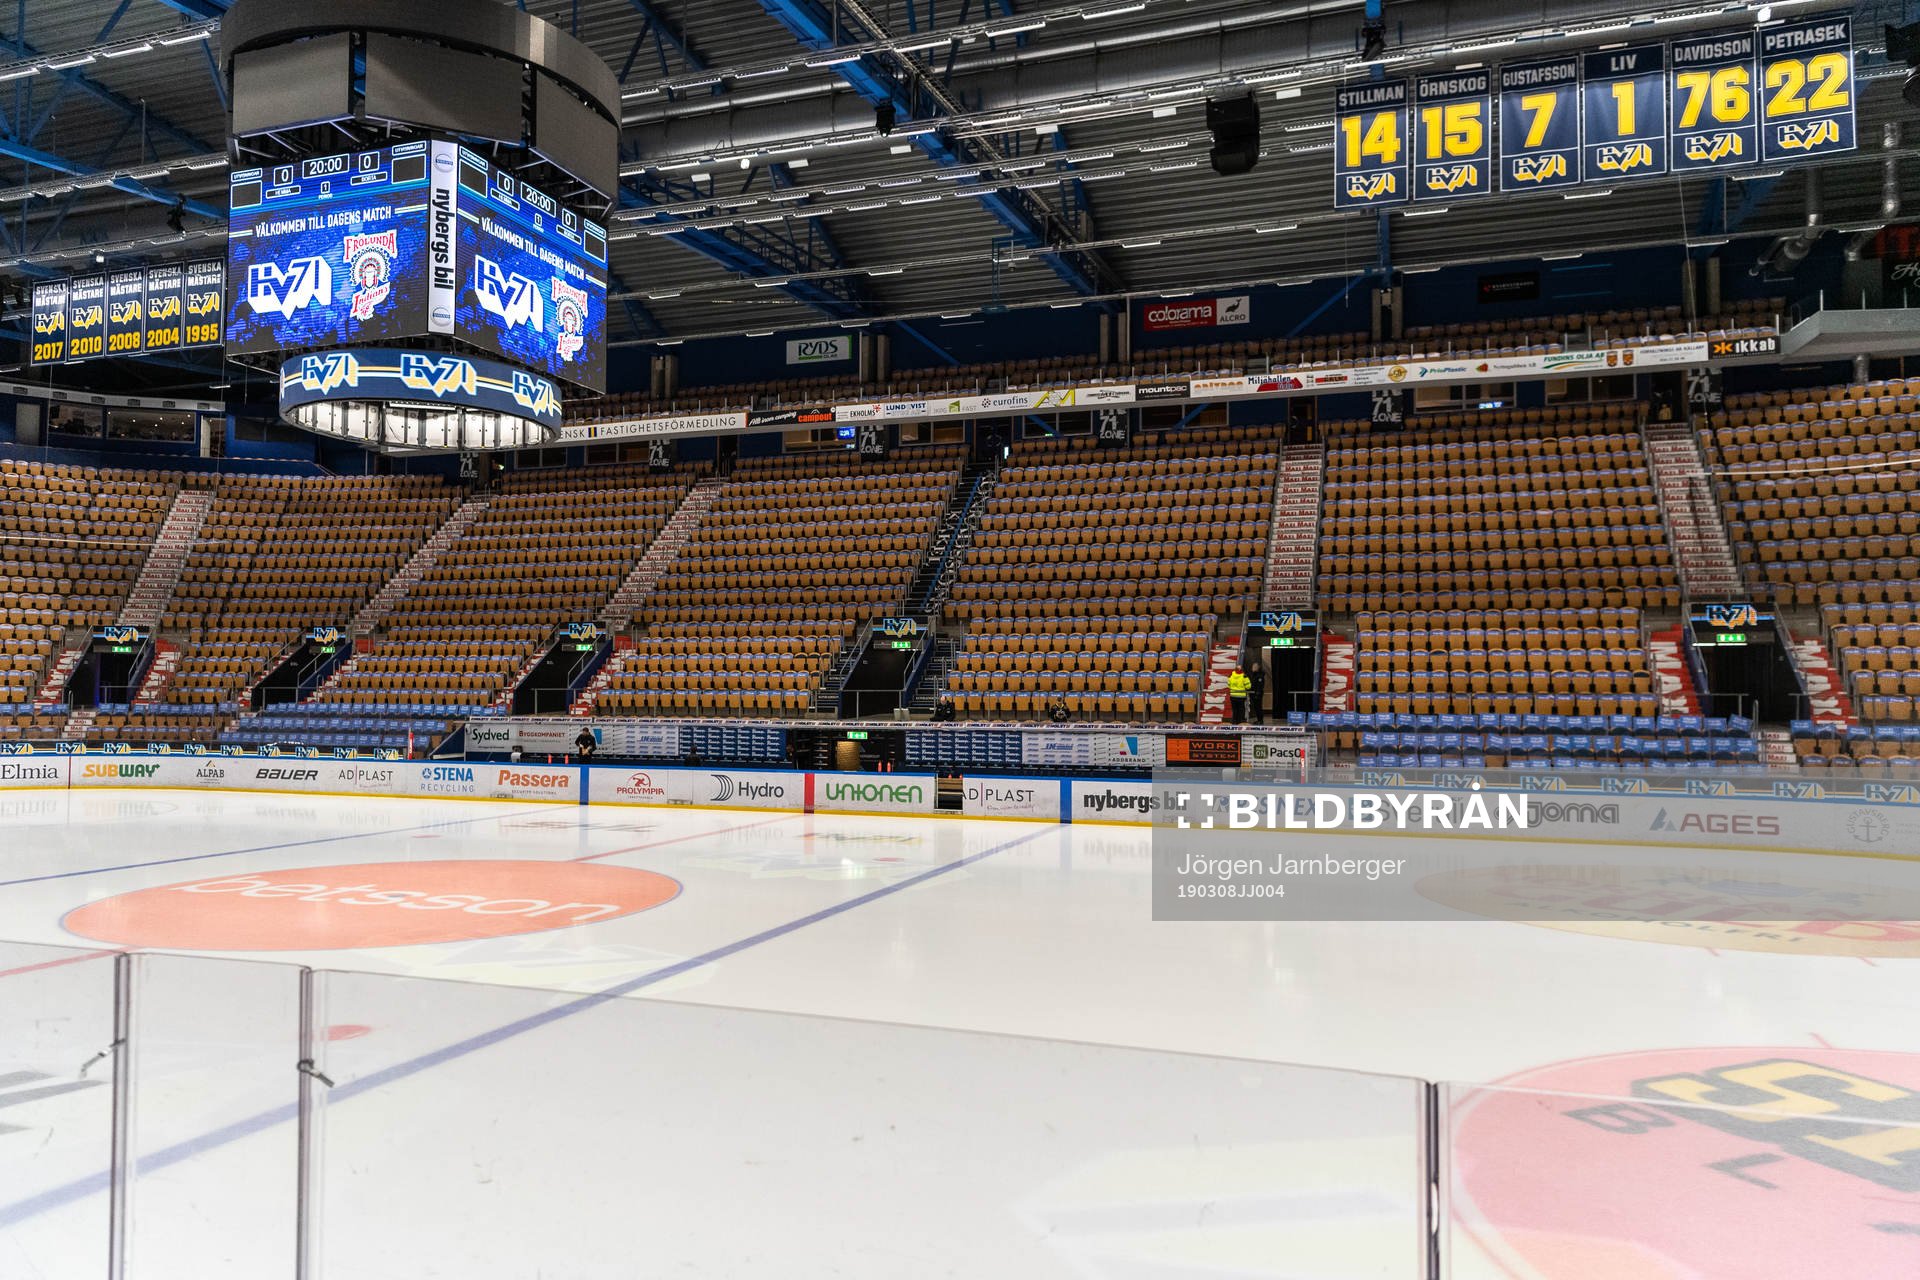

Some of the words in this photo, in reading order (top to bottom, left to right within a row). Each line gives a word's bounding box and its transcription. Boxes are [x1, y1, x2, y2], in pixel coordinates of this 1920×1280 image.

[1766, 24, 1847, 51] PETRASEK
[1675, 38, 1752, 63] DAVIDSSON
[1610, 54, 1637, 71] LIV
[1503, 62, 1575, 87] GUSTAFSSON
[1419, 76, 1487, 97] ÖRNSKOG
[1765, 52, 1850, 119] 22
[1339, 84, 1404, 106] STILLMAN
[1677, 65, 1749, 129] 76
[1612, 81, 1635, 137] 1
[1521, 92, 1558, 149] 7
[1342, 111, 1401, 168] 14
[1422, 102, 1483, 160] 15
[1777, 119, 1840, 153] HV71
[1686, 133, 1743, 163] HV71
[310, 158, 342, 175] 20:00
[364, 156, 371, 168] 0
[1597, 143, 1652, 173] HV71
[282, 169, 288, 181] 0
[1514, 153, 1567, 183] HV71
[504, 178, 510, 190] 0
[1347, 171, 1396, 200] HV71
[1427, 163, 1478, 192] HV71
[527, 188, 550, 211] 20:00
[256, 221, 306, 237] VÄLKOMMEN
[308, 217, 325, 230] TILL
[327, 212, 361, 228] DAGENS
[363, 206, 391, 222] MATCH
[431, 188, 455, 264] nybergs
[565, 213, 571, 225] 0
[482, 217, 523, 250] VÄLKOMMEN
[525, 238, 538, 258] TILL
[540, 246, 564, 270] DAGENS
[565, 259, 584, 280] MATCH
[149, 266, 181, 278] SVENSKA
[188, 262, 221, 274] SVENSKA
[73, 277, 103, 289] SVENSKA
[110, 272, 142, 283] SVENSKA
[149, 279, 181, 291] MÄSTARE
[248, 255, 332, 318] HV71
[434, 267, 454, 290] bil
[73, 288, 103, 300] MÄSTARE
[110, 284, 142, 296] MÄSTARE
[475, 255, 543, 332] HV71
[1148, 306, 1212, 322] colorama
[1220, 314, 1246, 322] ALCRO
[109, 332, 141, 351] 2008
[148, 328, 179, 347] 2004
[186, 323, 218, 343] 1995
[34, 342, 63, 360] 2017
[71, 336, 102, 355] 2010
[799, 340, 838, 356] RYDS
[1735, 339, 1775, 353] ikkab
[1544, 354, 1573, 362] FUNDINS
[302, 353, 359, 395] HV71
[401, 354, 477, 397] HV71
[1139, 385, 1188, 394] mountpac
[1688, 376, 1710, 392] 71
[512, 371, 553, 416] HV71
[993, 396, 1028, 406] eurofins
[1372, 397, 1392, 413] 71
[600, 416, 736, 436] FASTIGHETSFÖRMEDLING
[798, 413, 832, 423] campout
[1100, 416, 1116, 430] 71
[860, 432, 876, 446] 71
[1261, 612, 1302, 634] HV71
[1706, 605, 1757, 628] HV71
[104, 627, 138, 643] HV71
[314, 627, 338, 644] HV71
[568, 623, 596, 641] HV71
[883, 619, 916, 638] HV71
[472, 728, 509, 744] Sydved
[1192, 742, 1236, 750] WORK
[1270, 748, 1300, 758] PacsO
[1, 763, 59, 779] Elmia
[82, 764, 160, 778] SUBWAY
[196, 769, 225, 778] ALPAB
[434, 767, 473, 782] STENA
[498, 770, 569, 788] Passera
[420, 783, 474, 792] RECYCLING
[616, 787, 665, 795] PROLYMPIA
[739, 781, 784, 799] Hydro
[1083, 790, 1160, 813] nybergs
[1526, 801, 1619, 828] joma
[1679, 813, 1780, 836] AGES
[168, 876, 622, 922] betsson
